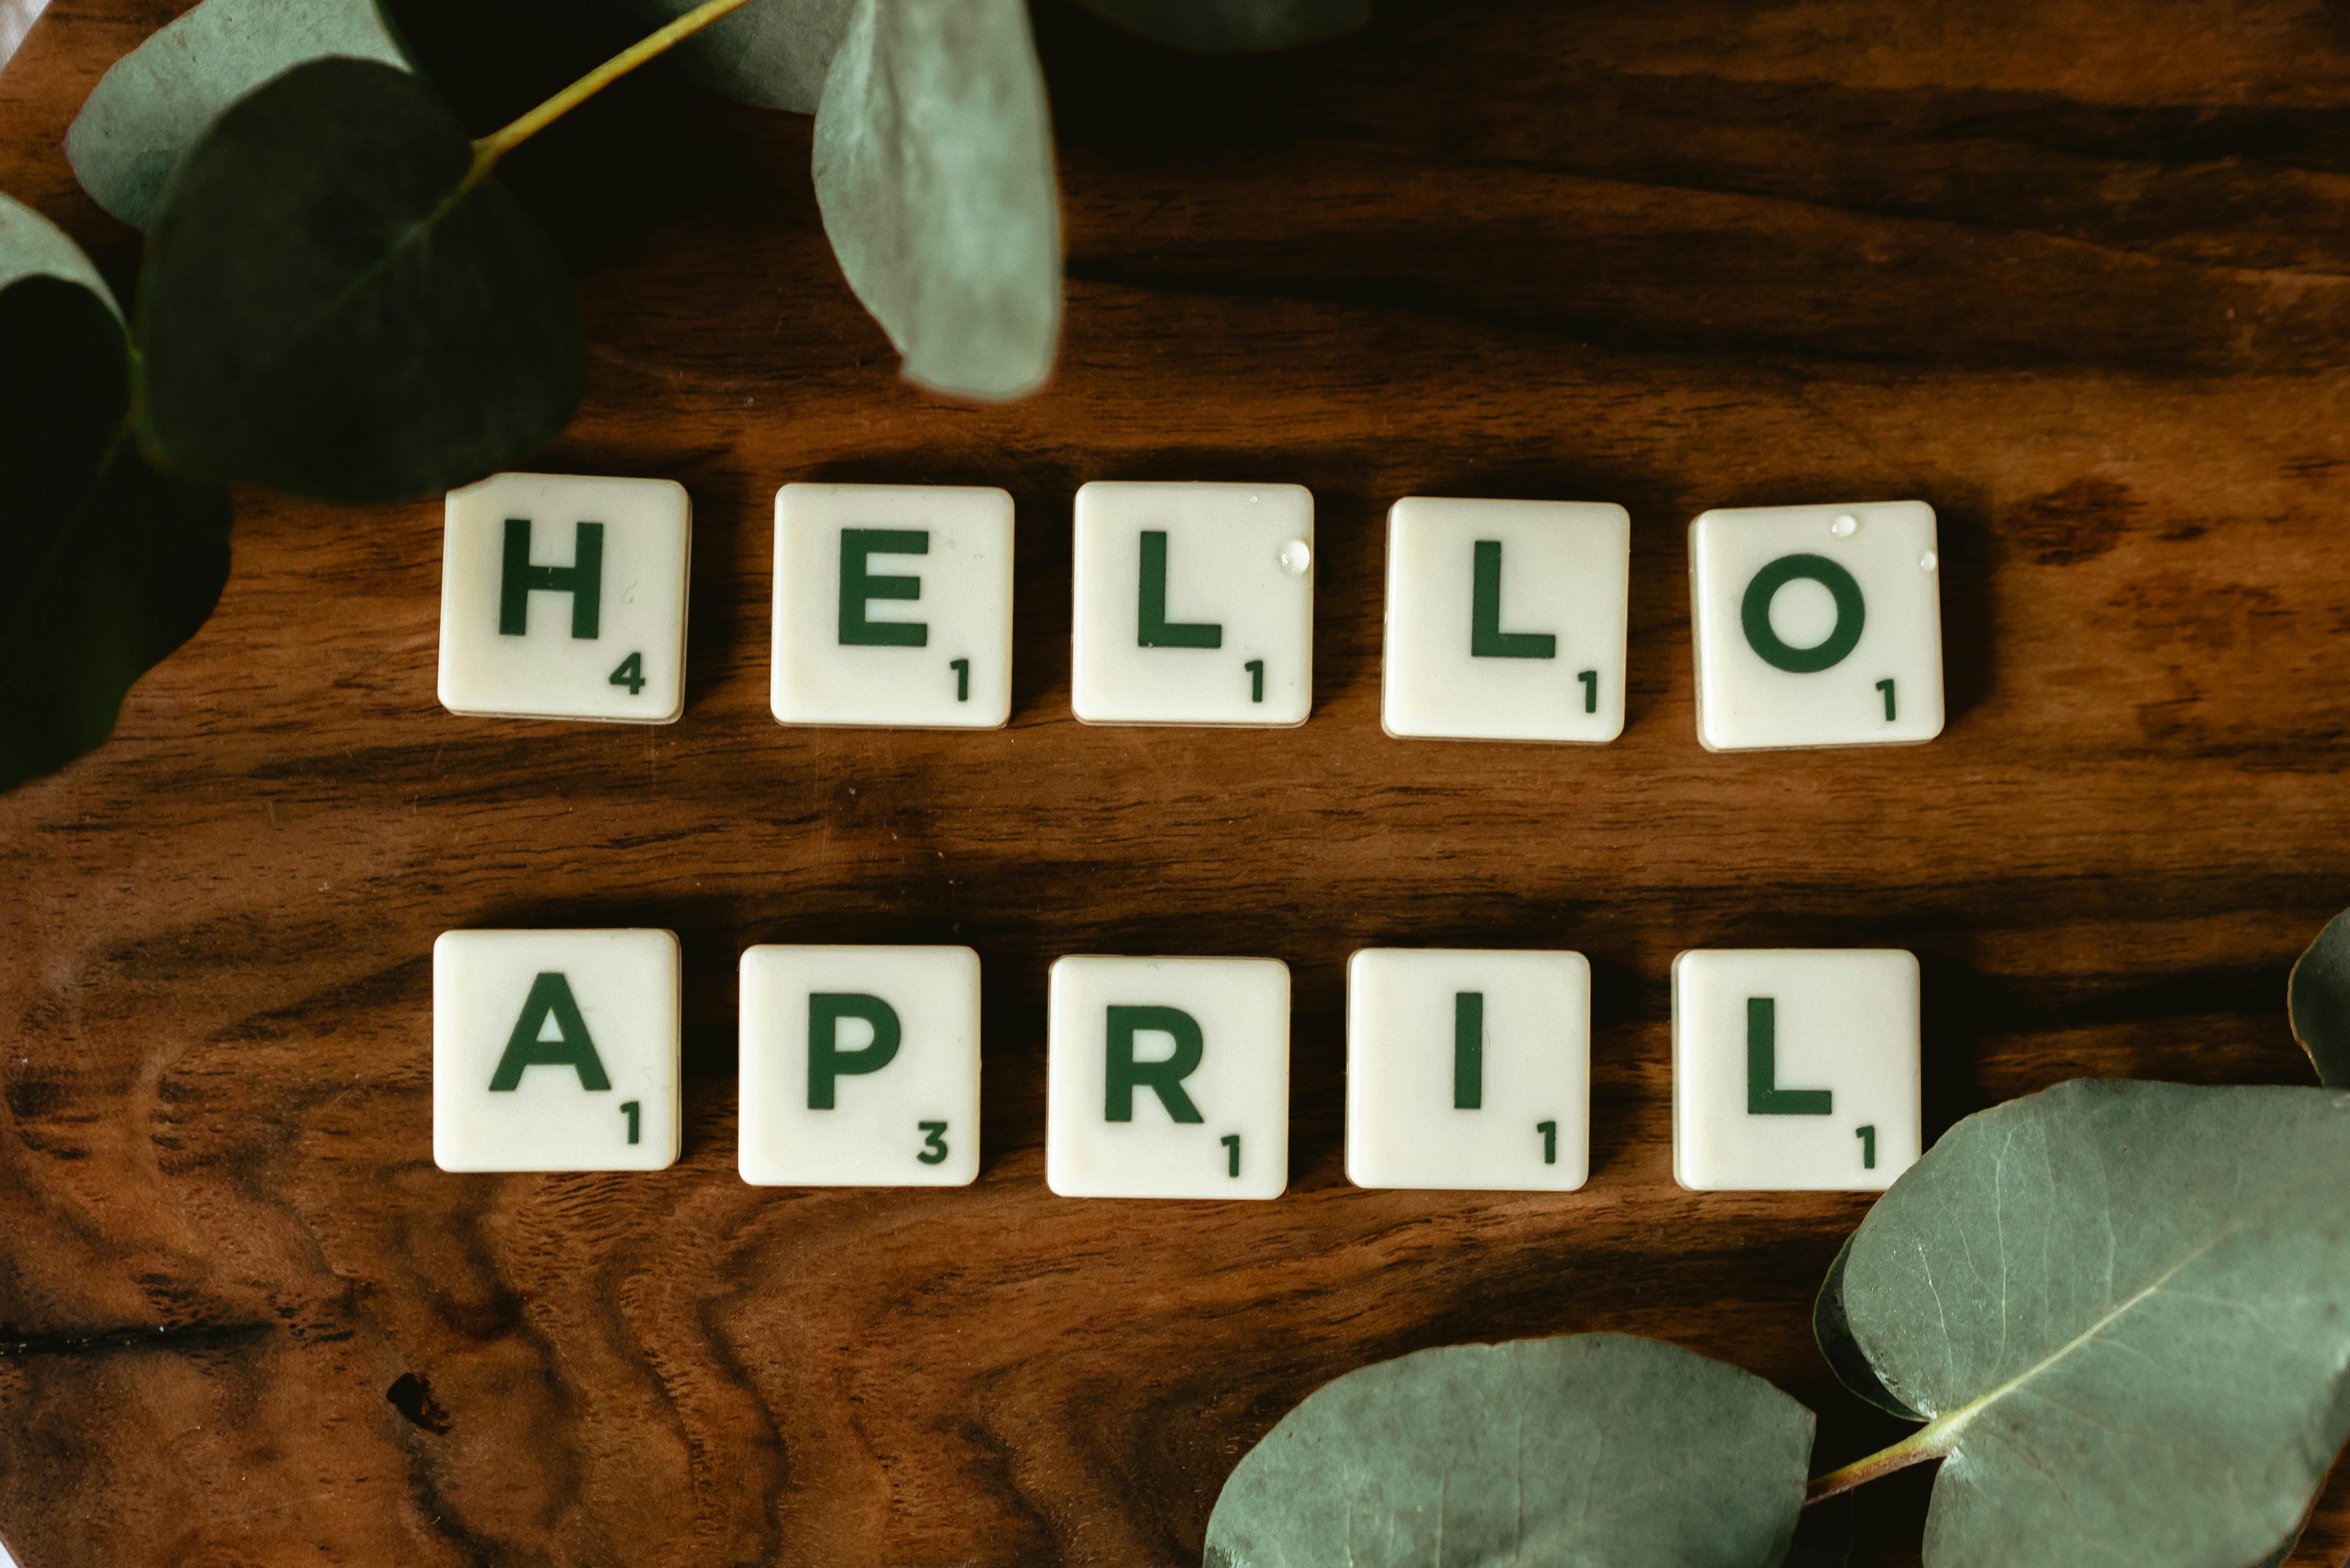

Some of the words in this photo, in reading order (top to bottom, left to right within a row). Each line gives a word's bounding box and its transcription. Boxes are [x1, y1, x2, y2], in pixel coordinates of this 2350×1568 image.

[499, 516, 1867, 674] HELLO
[608, 652, 646, 696] 4
[950, 658, 969, 702] 1
[1244, 659, 1264, 703] 1
[1577, 670, 1597, 714] 1
[1875, 679, 1896, 722] 1
[489, 971, 1833, 1125] APRIL
[620, 1101, 640, 1145] 1
[916, 1121, 948, 1165] 3
[1536, 1120, 1556, 1164] 1
[1220, 1134, 1240, 1178] 1
[1855, 1125, 1875, 1170] 1
